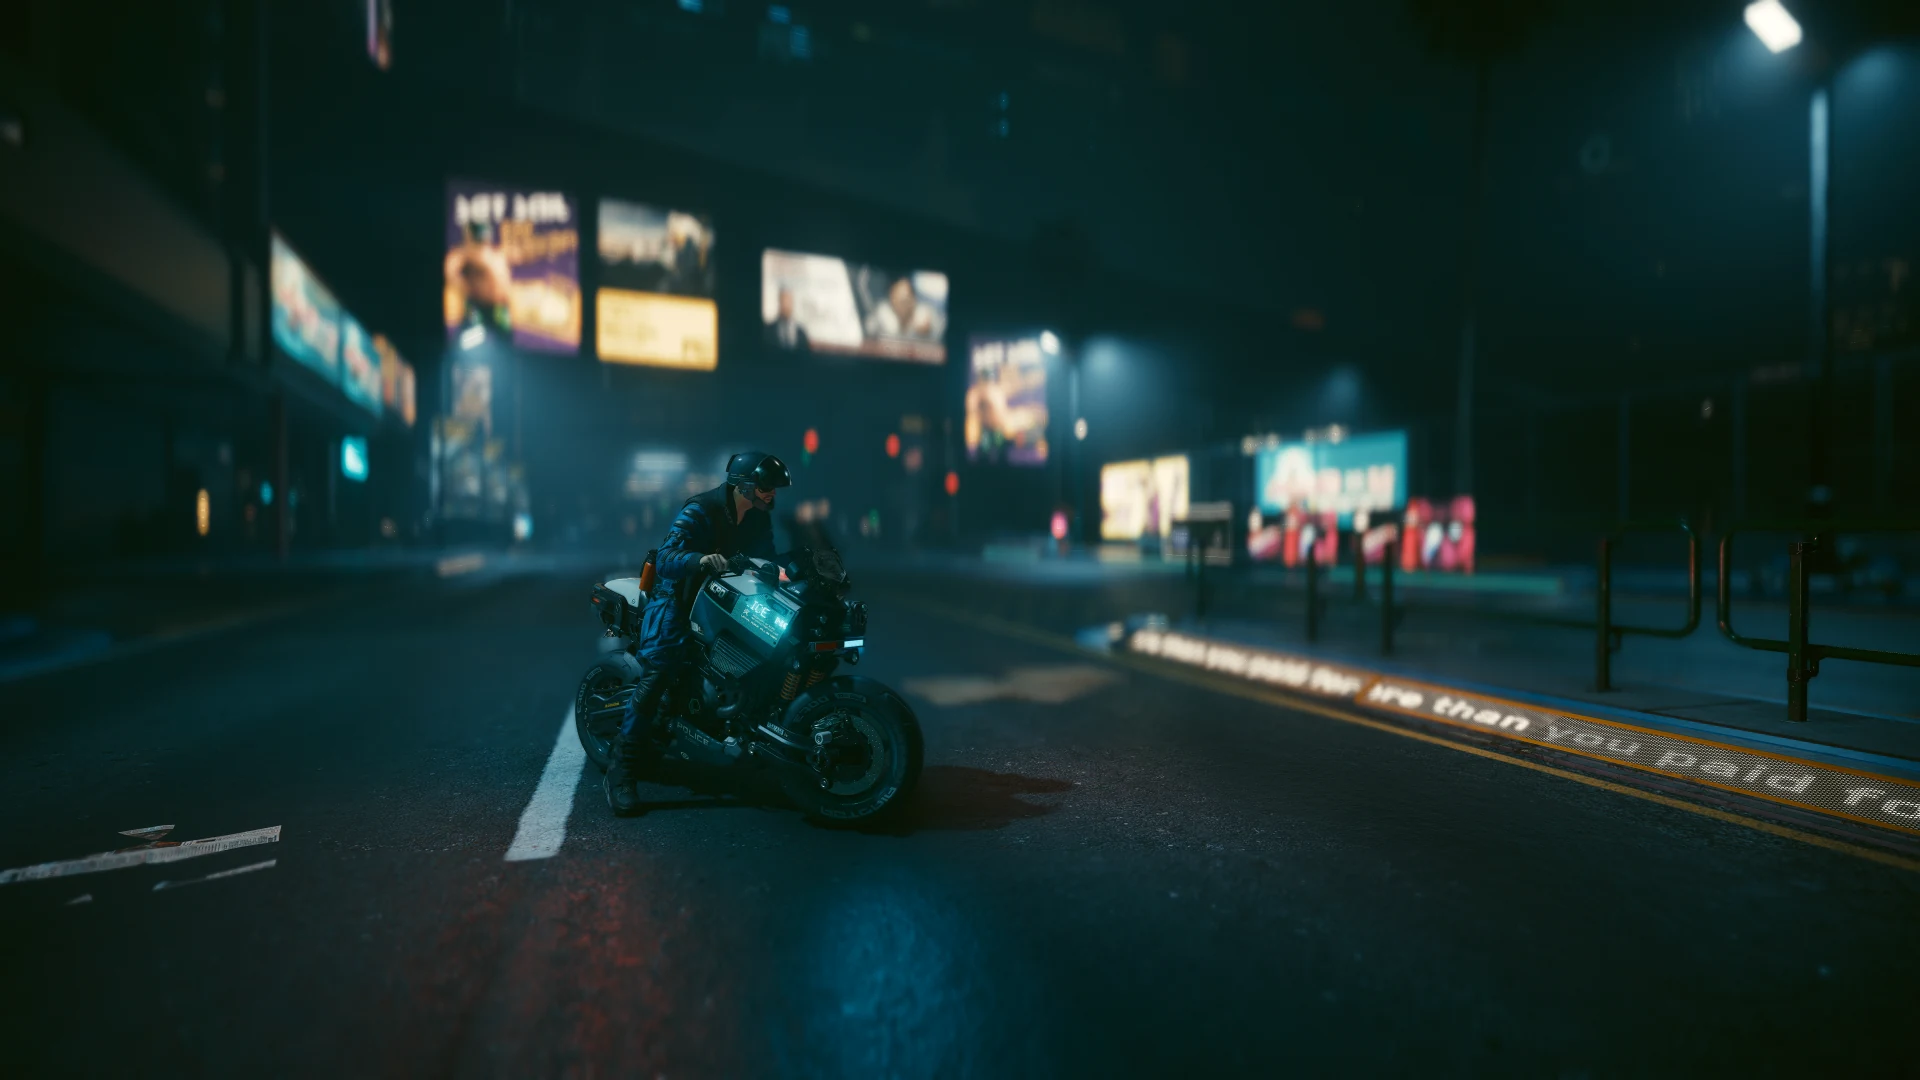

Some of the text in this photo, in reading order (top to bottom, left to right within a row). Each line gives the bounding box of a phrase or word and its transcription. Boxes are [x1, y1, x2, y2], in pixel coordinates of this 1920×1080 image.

[1433, 696, 1530, 732] than
[1543, 721, 1640, 757] you
[1654, 750, 1816, 796] paid
